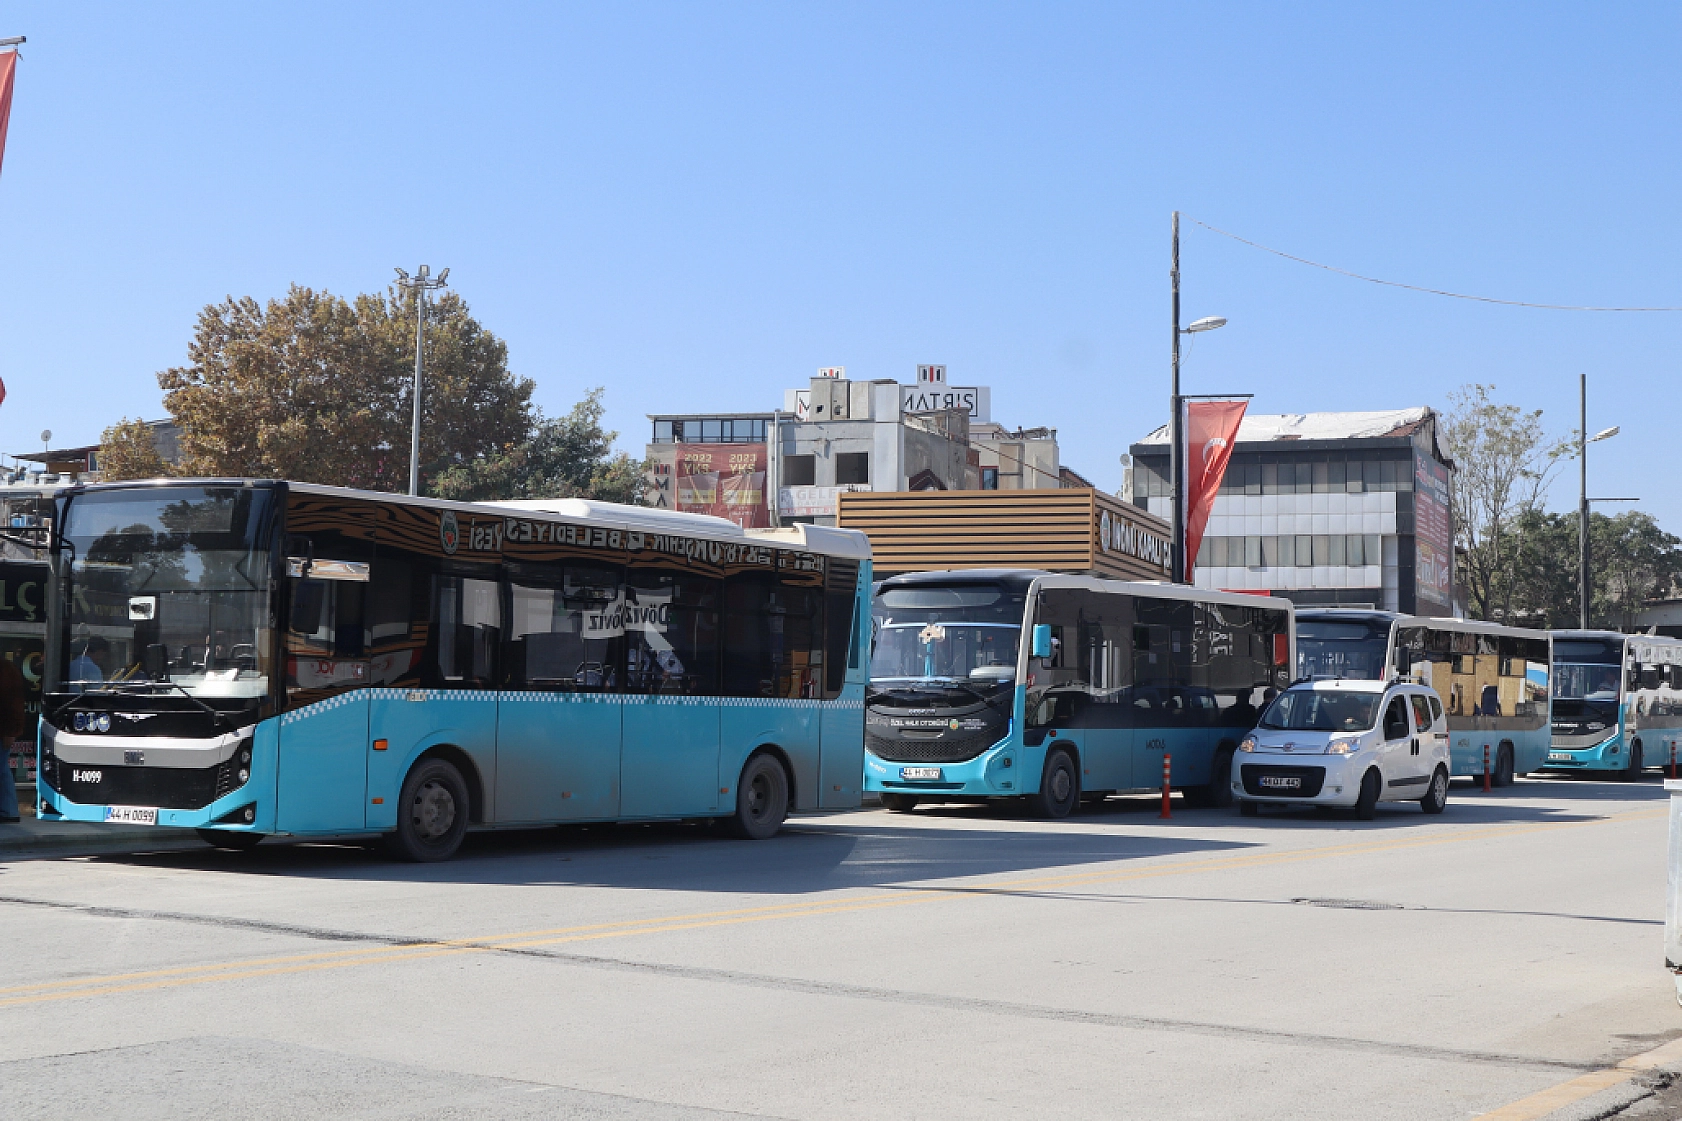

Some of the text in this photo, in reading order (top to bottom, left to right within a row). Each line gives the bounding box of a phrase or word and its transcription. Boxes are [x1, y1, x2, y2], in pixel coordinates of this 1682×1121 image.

[684, 453, 712, 463] 2022
[729, 453, 757, 464] 2023
[72, 769, 102, 783] H-0099
[111, 807, 121, 820] 44
[132, 809, 154, 823] 0099
